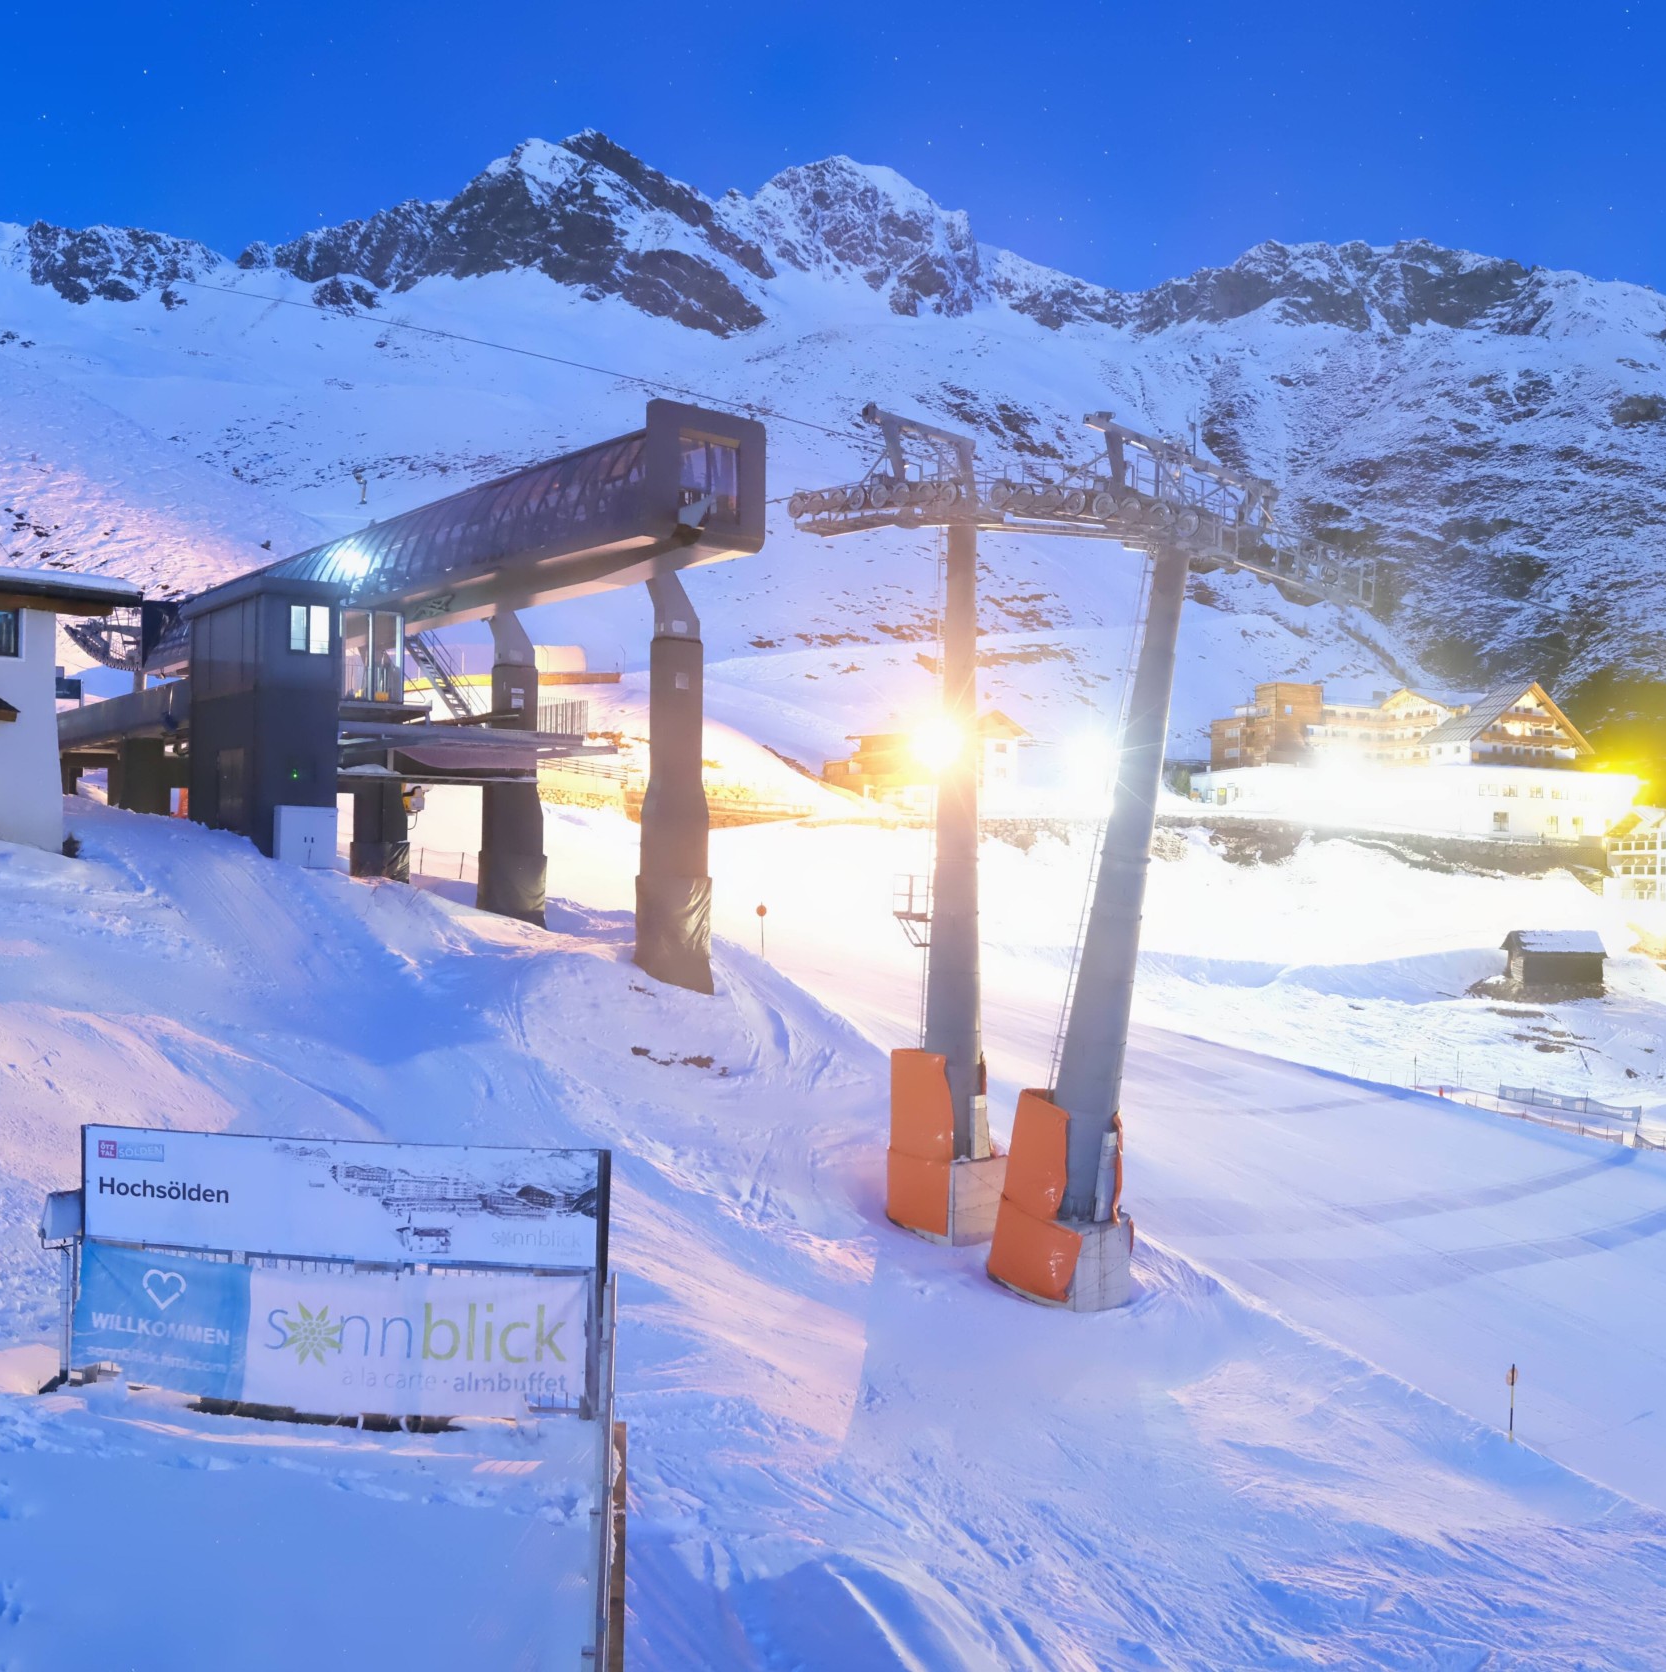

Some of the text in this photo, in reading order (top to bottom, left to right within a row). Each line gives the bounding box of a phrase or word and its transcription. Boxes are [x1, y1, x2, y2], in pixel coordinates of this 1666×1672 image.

[100, 1149, 115, 1157] TAL
[99, 1176, 229, 1204] Hochsölden
[91, 1311, 230, 1346] WILLKOMMEN
[361, 1366, 377, 1388] la
[384, 1370, 437, 1391] carte
[452, 1371, 567, 1393] almbuffet
